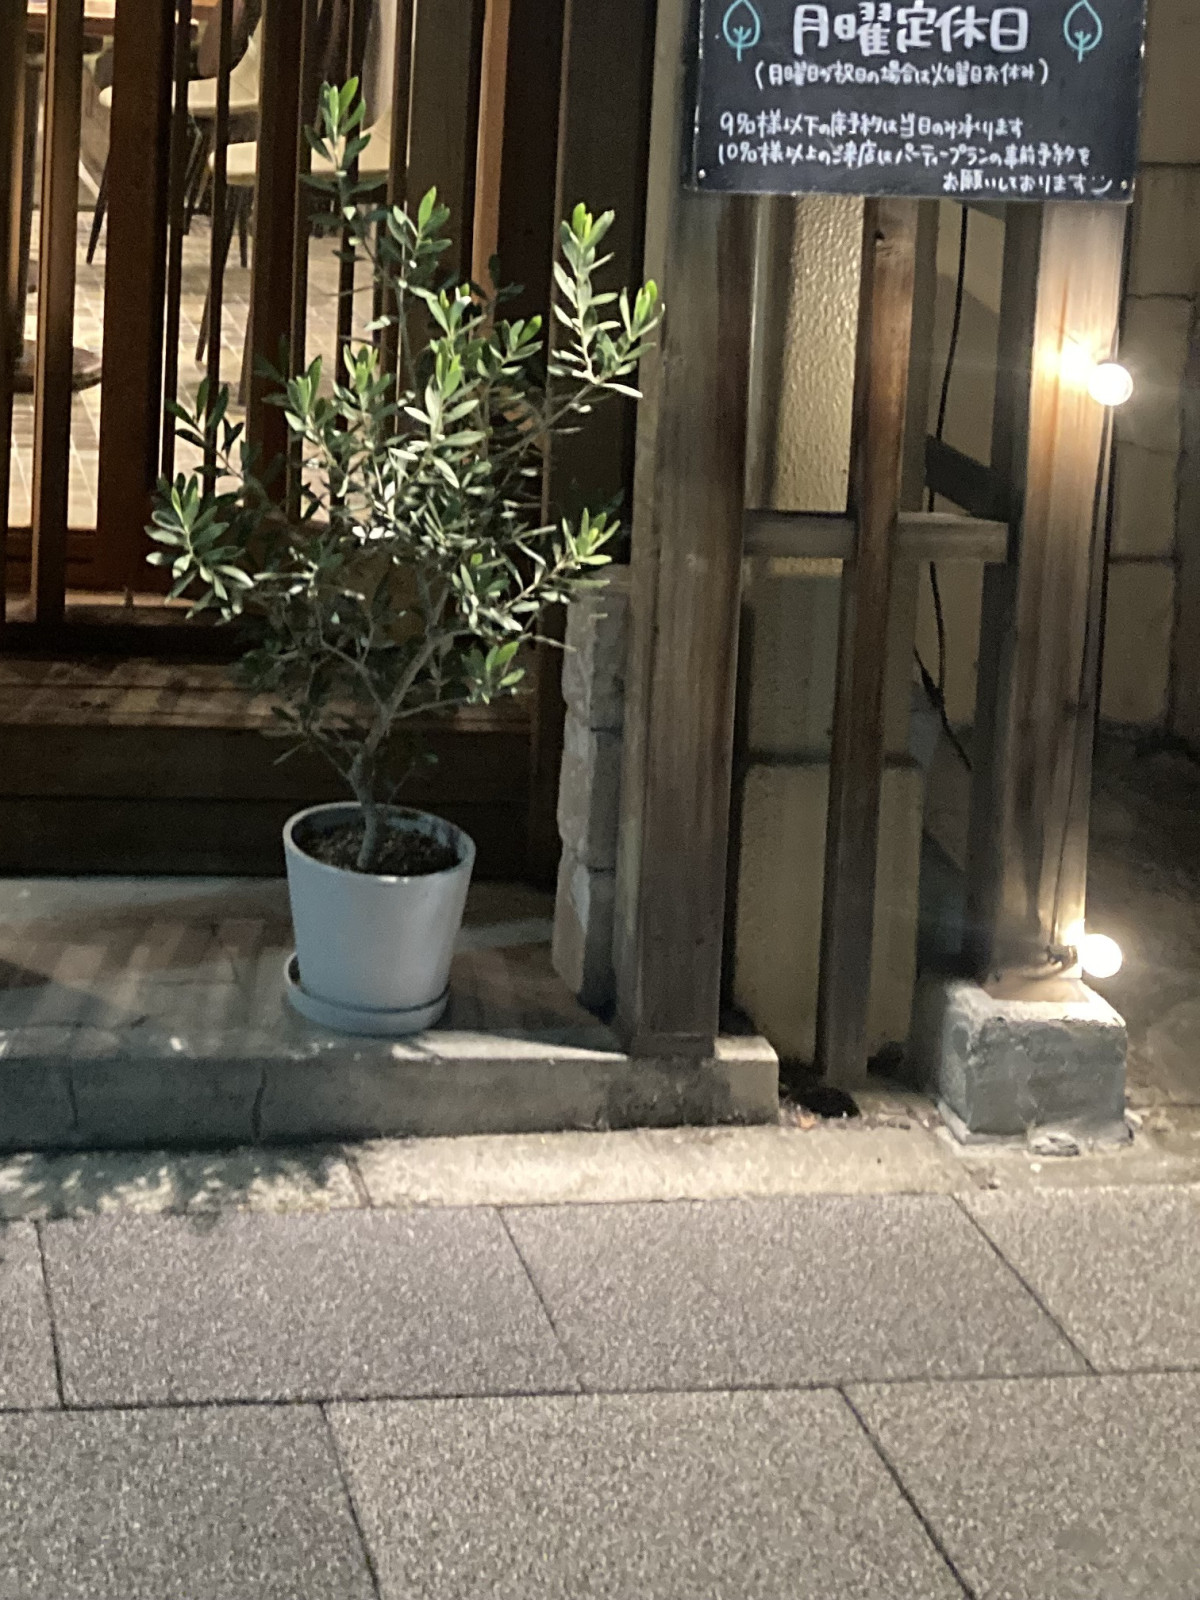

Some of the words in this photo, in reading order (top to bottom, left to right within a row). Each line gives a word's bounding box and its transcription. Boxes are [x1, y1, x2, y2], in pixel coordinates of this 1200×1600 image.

[792, 0, 1029, 57] 月曜定休日
